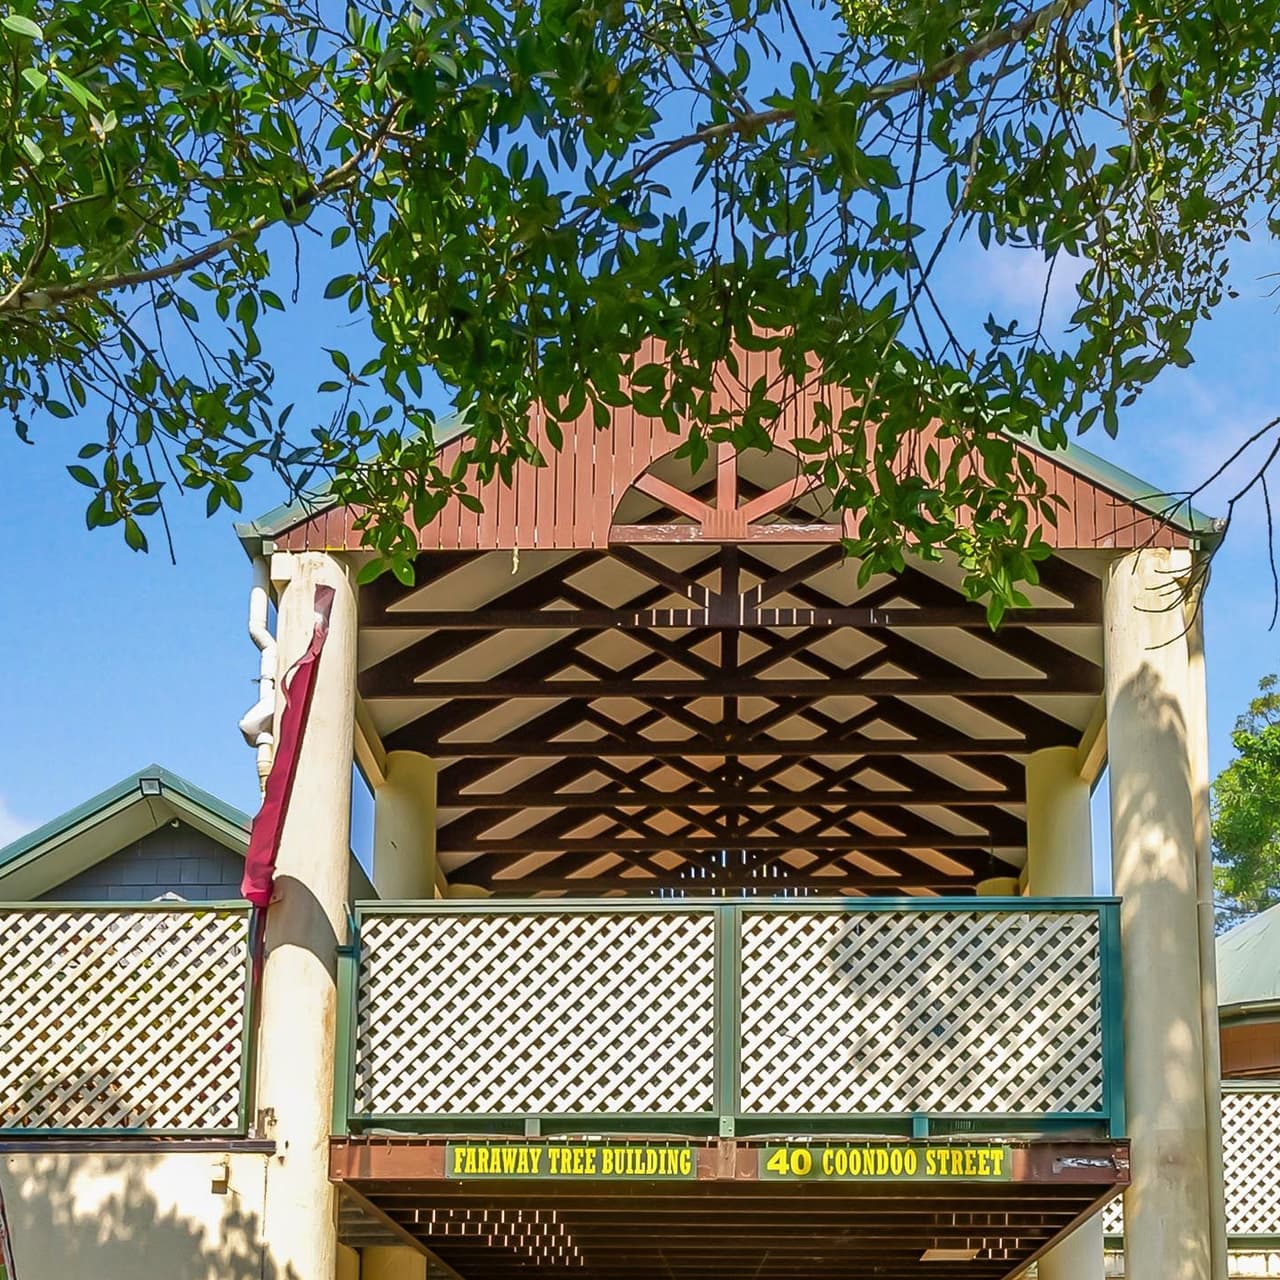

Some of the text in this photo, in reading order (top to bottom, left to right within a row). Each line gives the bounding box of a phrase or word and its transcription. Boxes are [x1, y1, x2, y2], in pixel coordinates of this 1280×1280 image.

[454, 1147, 691, 1175] FARAWAY TREE BUILDING
[766, 1149, 1004, 1176] 40 COONDOO STREET
